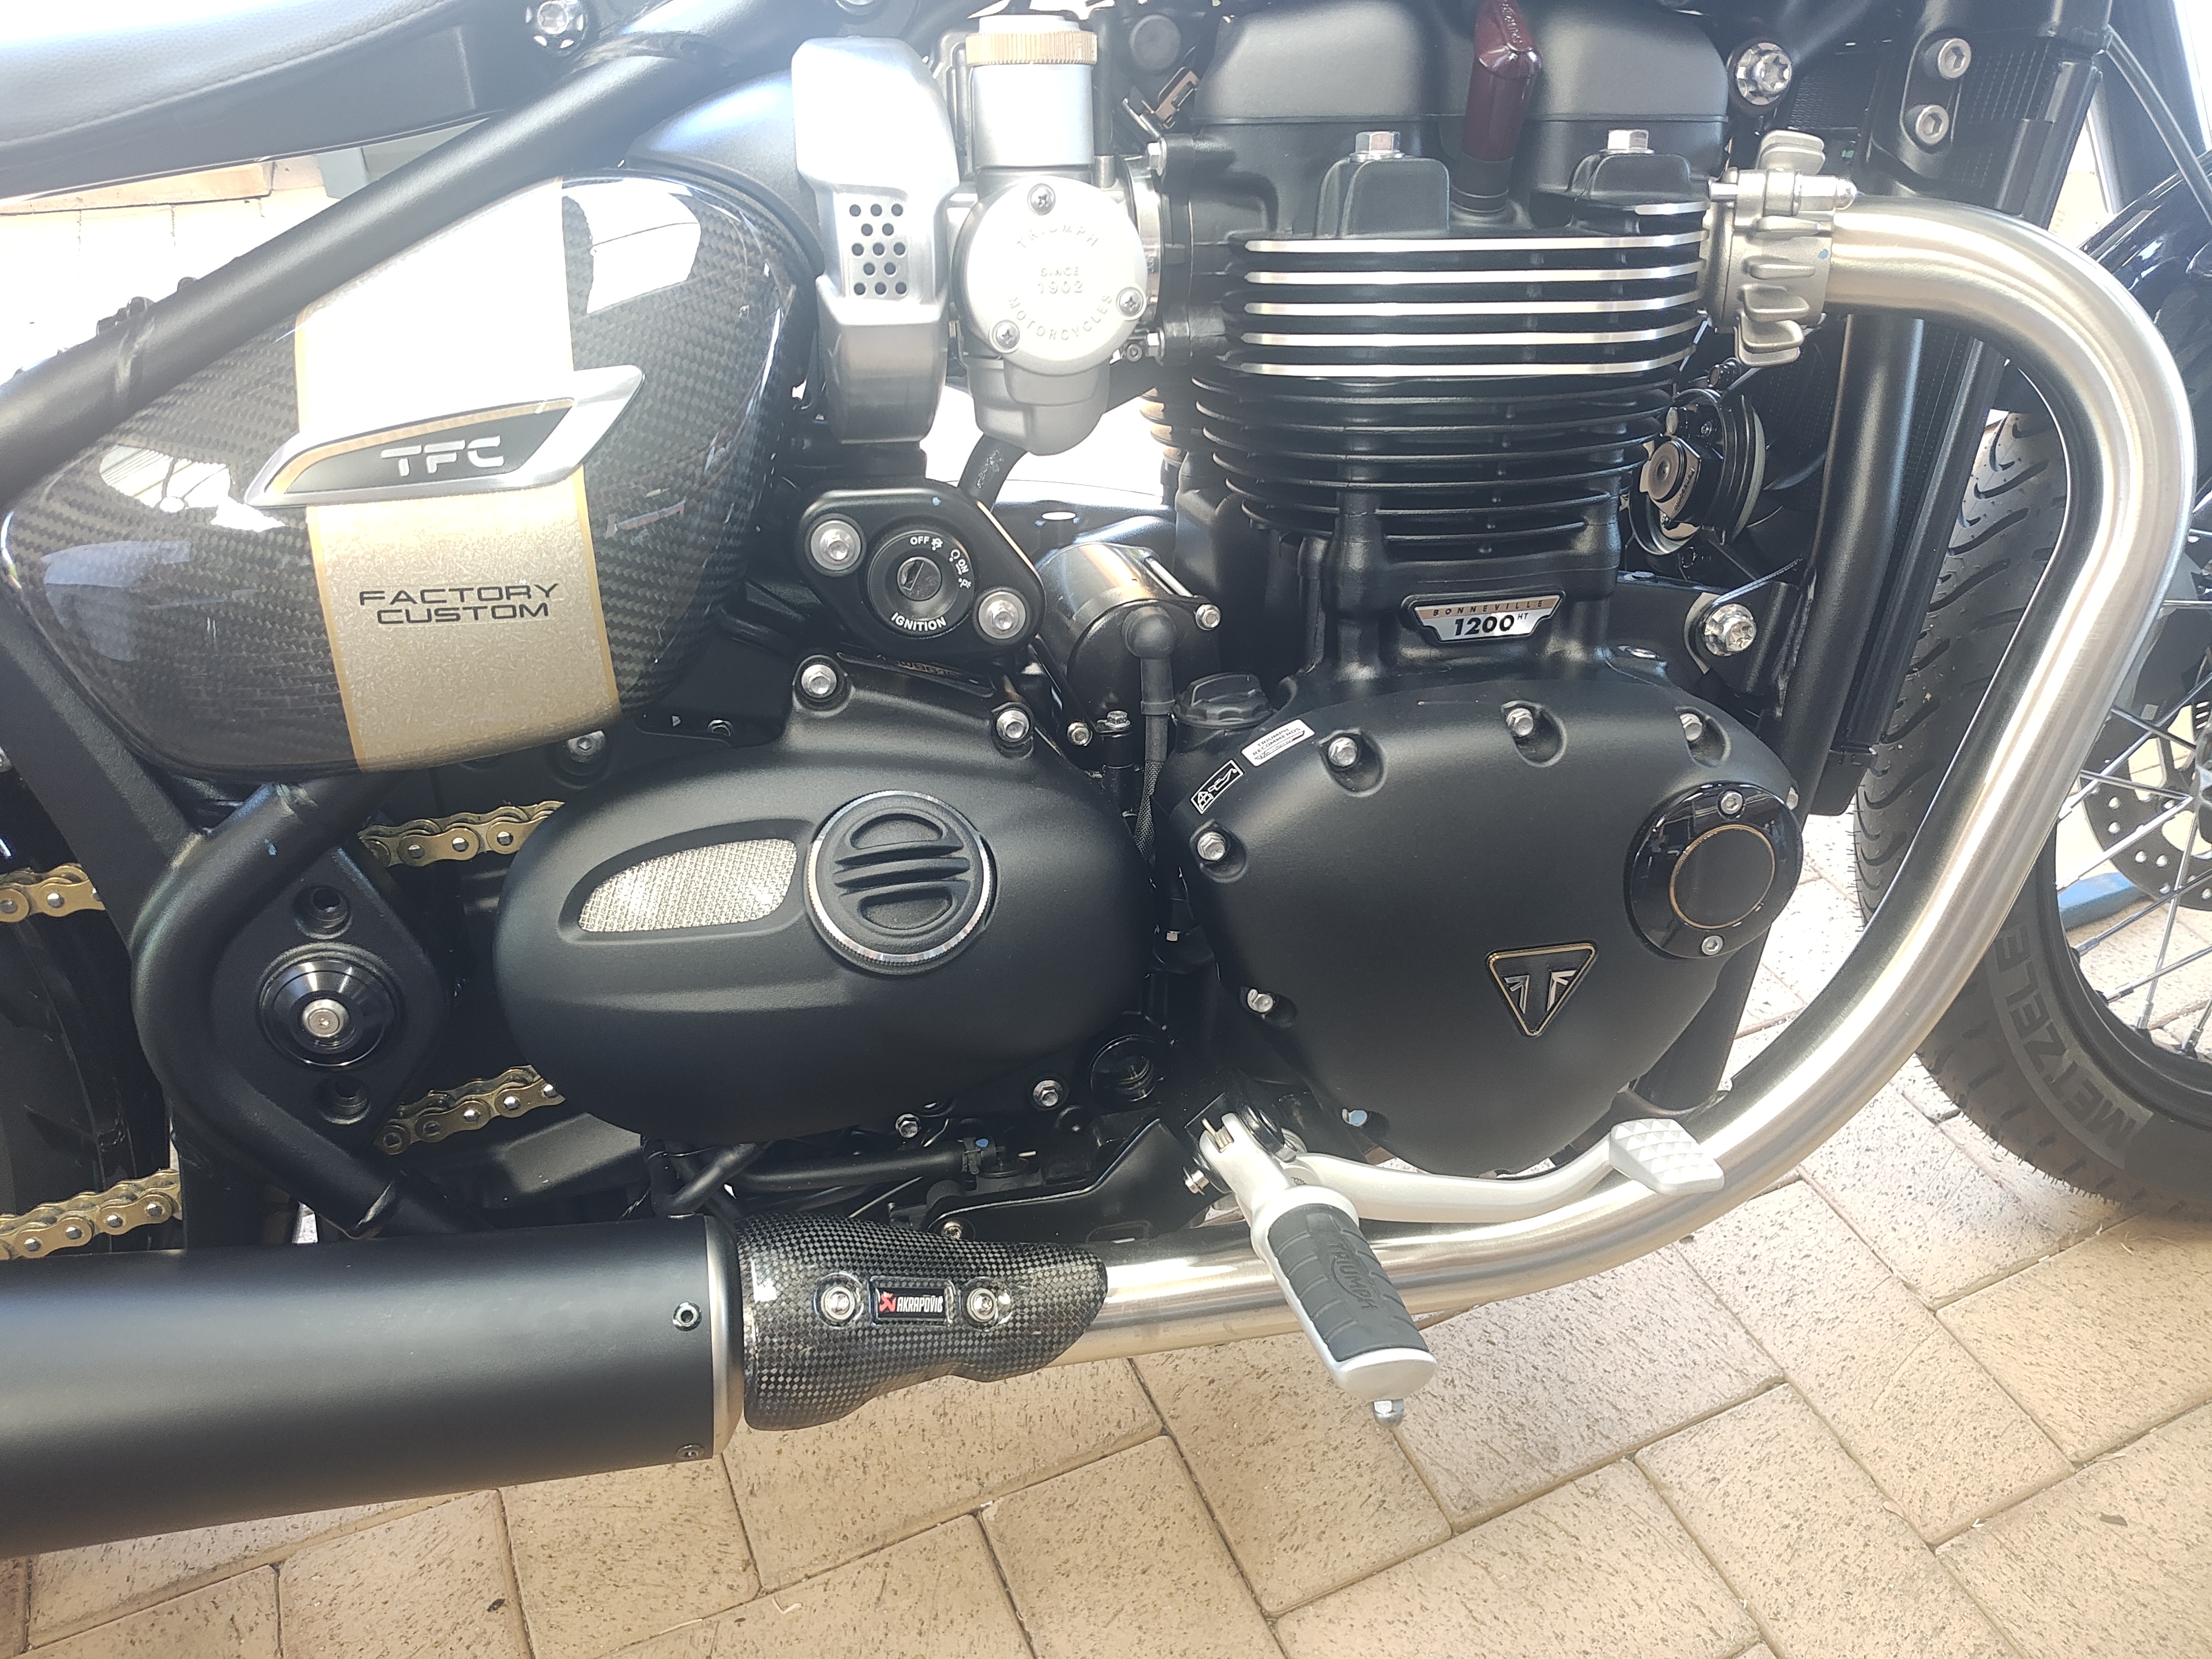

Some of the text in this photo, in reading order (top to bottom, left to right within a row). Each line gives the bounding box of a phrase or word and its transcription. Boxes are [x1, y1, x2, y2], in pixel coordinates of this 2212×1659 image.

[1017, 224, 1099, 248] TRUMPH
[1041, 267, 1079, 276] SINCE
[1038, 280, 1082, 294] 1902
[1008, 295, 1112, 340] MOTORCYCLES
[381, 436, 504, 476] TFC
[910, 536, 930, 545] OFF
[958, 559, 969, 573] ON
[359, 583, 559, 606] FACTORY
[377, 602, 549, 625] CUSTOM
[1434, 600, 1543, 617] BONNEVILLE
[891, 612, 946, 631] IGNITION
[1454, 615, 1514, 636] 1200
[1252, 727, 1300, 755] RECOMMENDS
[1257, 728, 1289, 747] TRIUMPH
[1994, 915, 2138, 1149] METZELE
